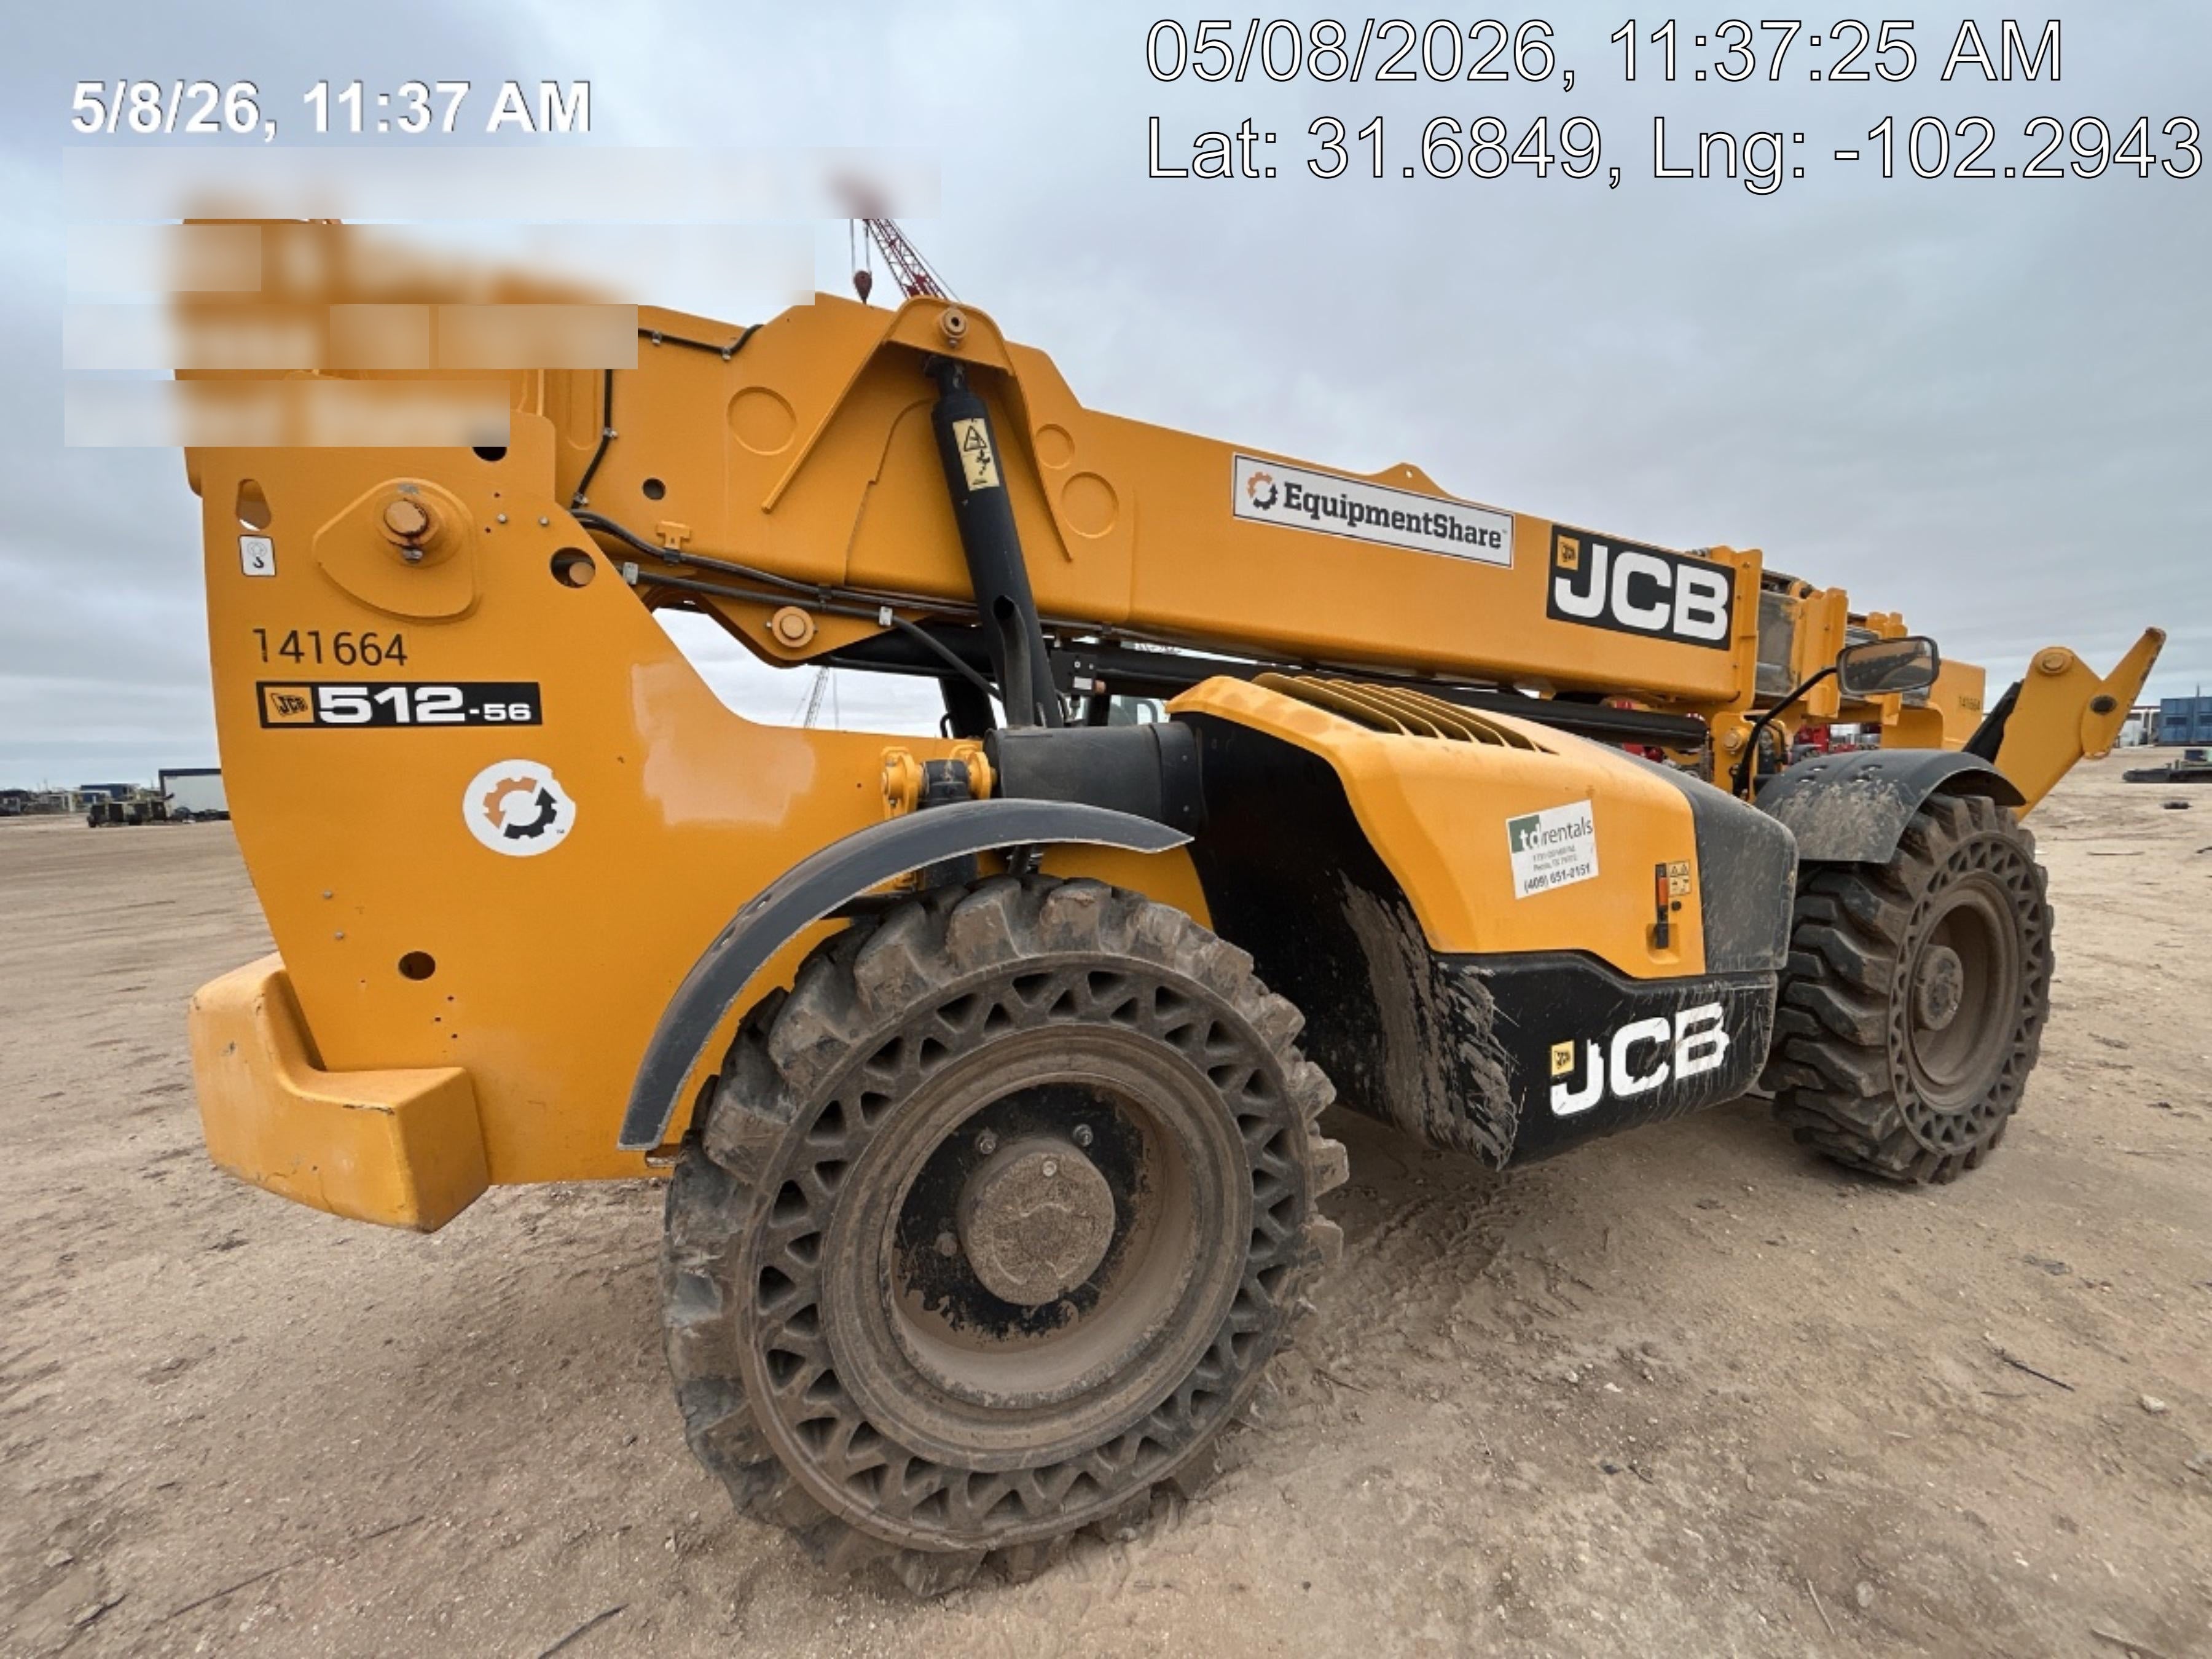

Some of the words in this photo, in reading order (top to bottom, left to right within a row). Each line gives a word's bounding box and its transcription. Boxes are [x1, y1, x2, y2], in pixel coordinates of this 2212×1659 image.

[1283, 481, 1502, 549] EquipmentShare
[1555, 543, 1729, 640] JCB
[253, 628, 408, 666] 141664
[318, 686, 531, 724] 512-56
[1551, 1002, 1730, 1116] JCB
